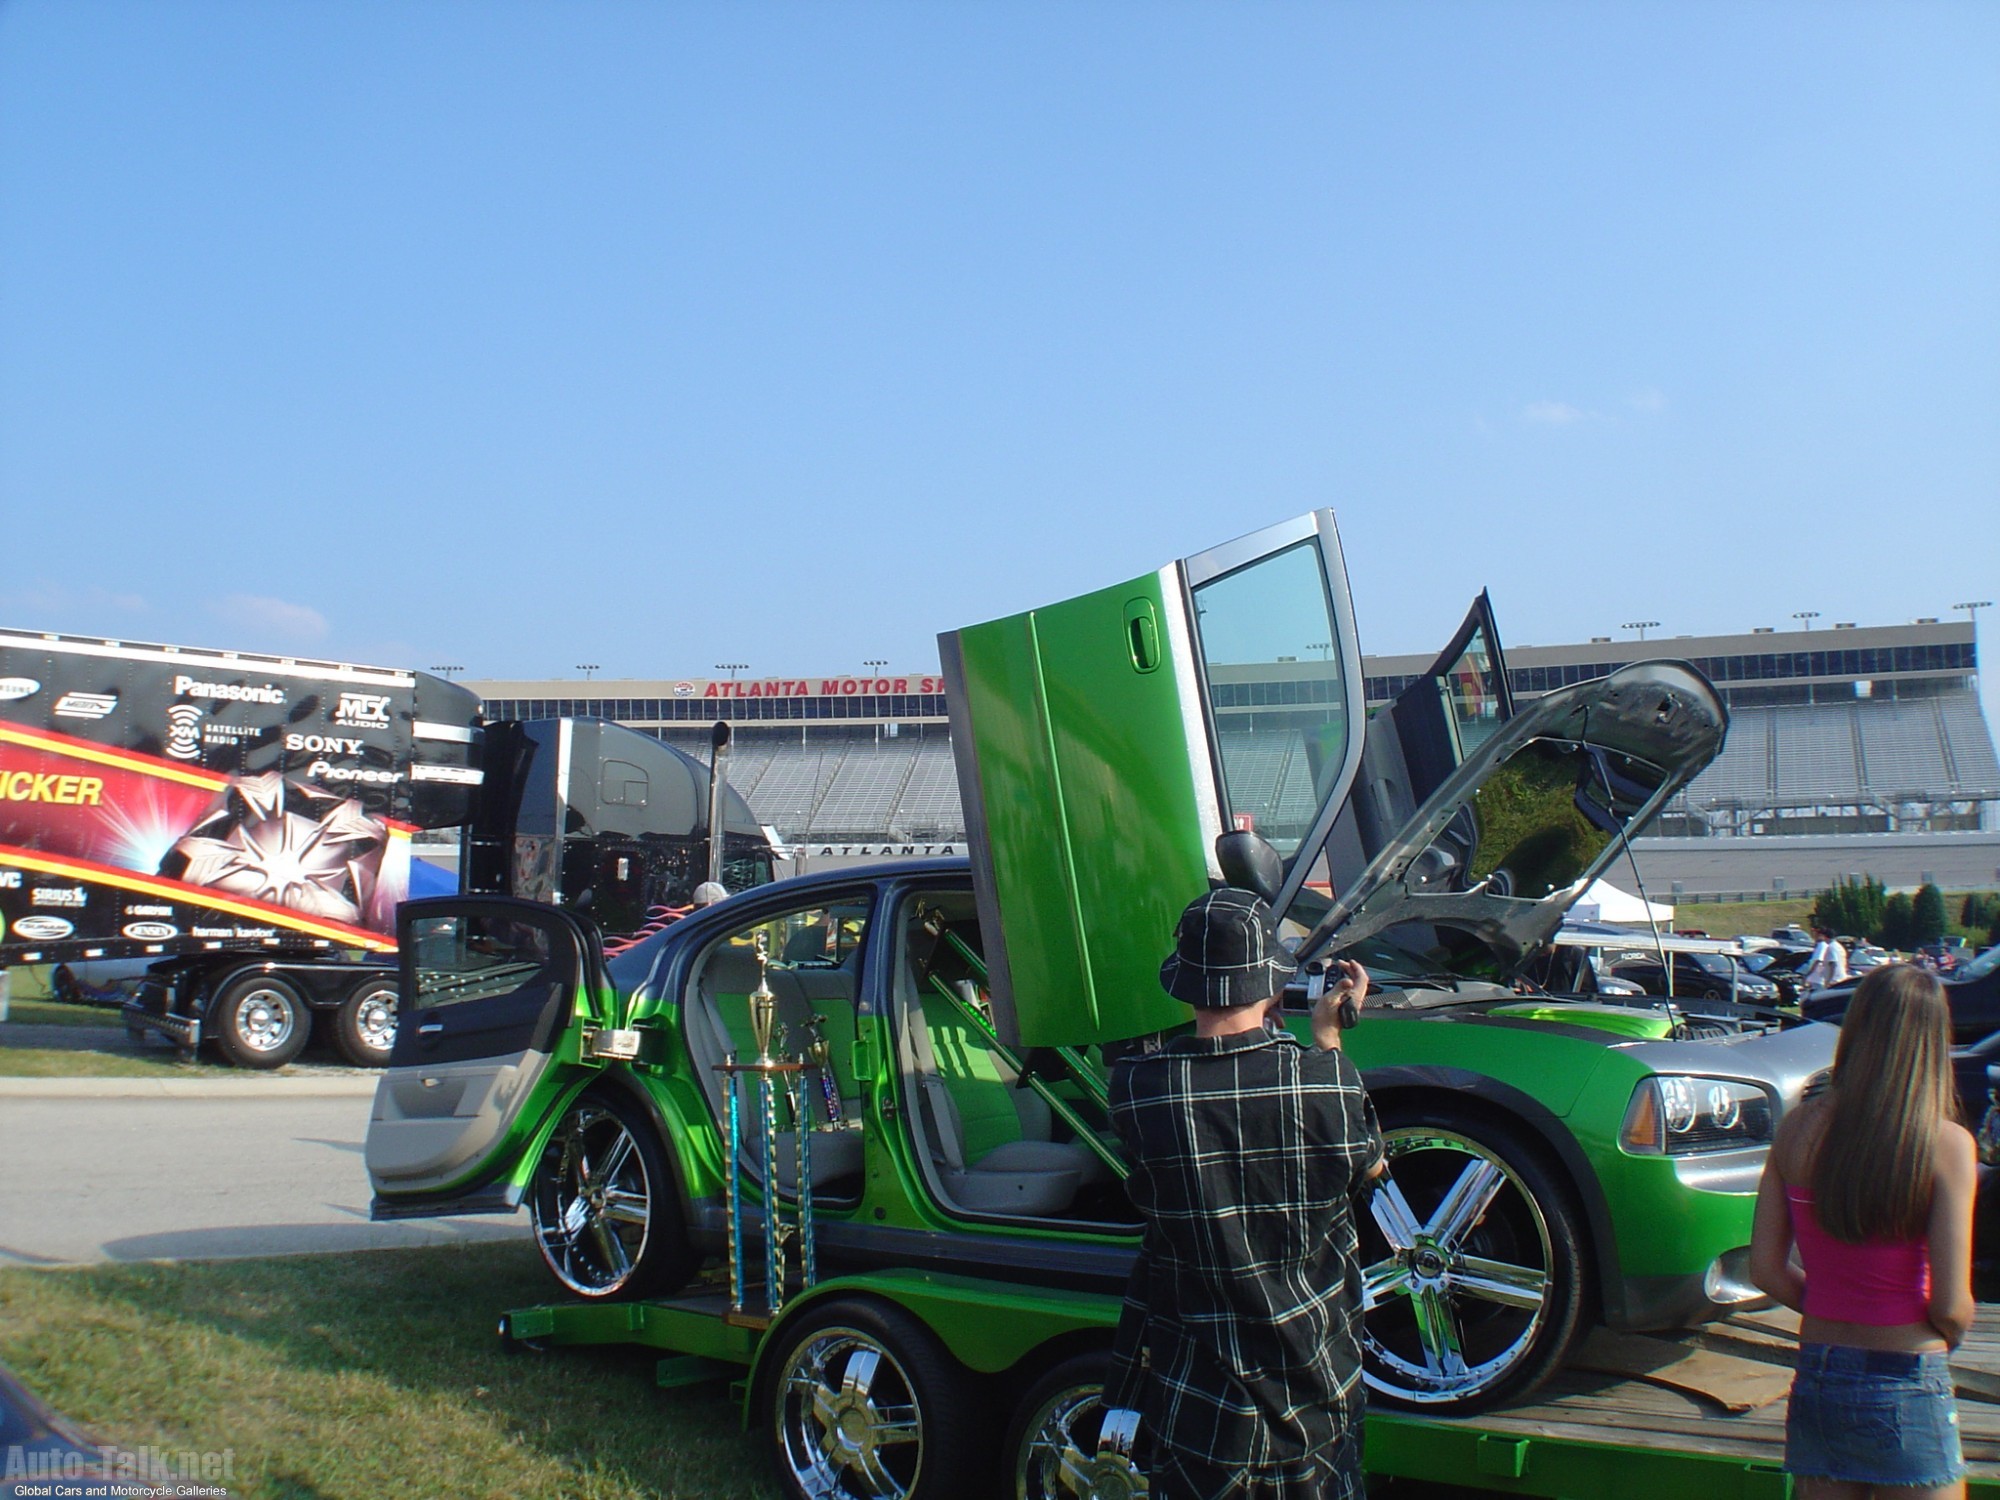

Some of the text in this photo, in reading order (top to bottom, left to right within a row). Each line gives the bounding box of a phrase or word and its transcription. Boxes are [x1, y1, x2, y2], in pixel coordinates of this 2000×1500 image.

[175, 675, 286, 704] Panasonic
[704, 681, 809, 697] ATLANTA
[821, 679, 907, 695] MOTOR
[335, 693, 391, 722] MTX
[170, 724, 200, 740] XM
[336, 718, 389, 730] AUDIO
[204, 735, 239, 746] RADIO
[286, 733, 364, 756] SONY
[307, 760, 404, 784] Pioneer
[0, 771, 104, 806] ICKER
[820, 845, 955, 855] ATLANTA
[31, 887, 73, 902] SIRIUS
